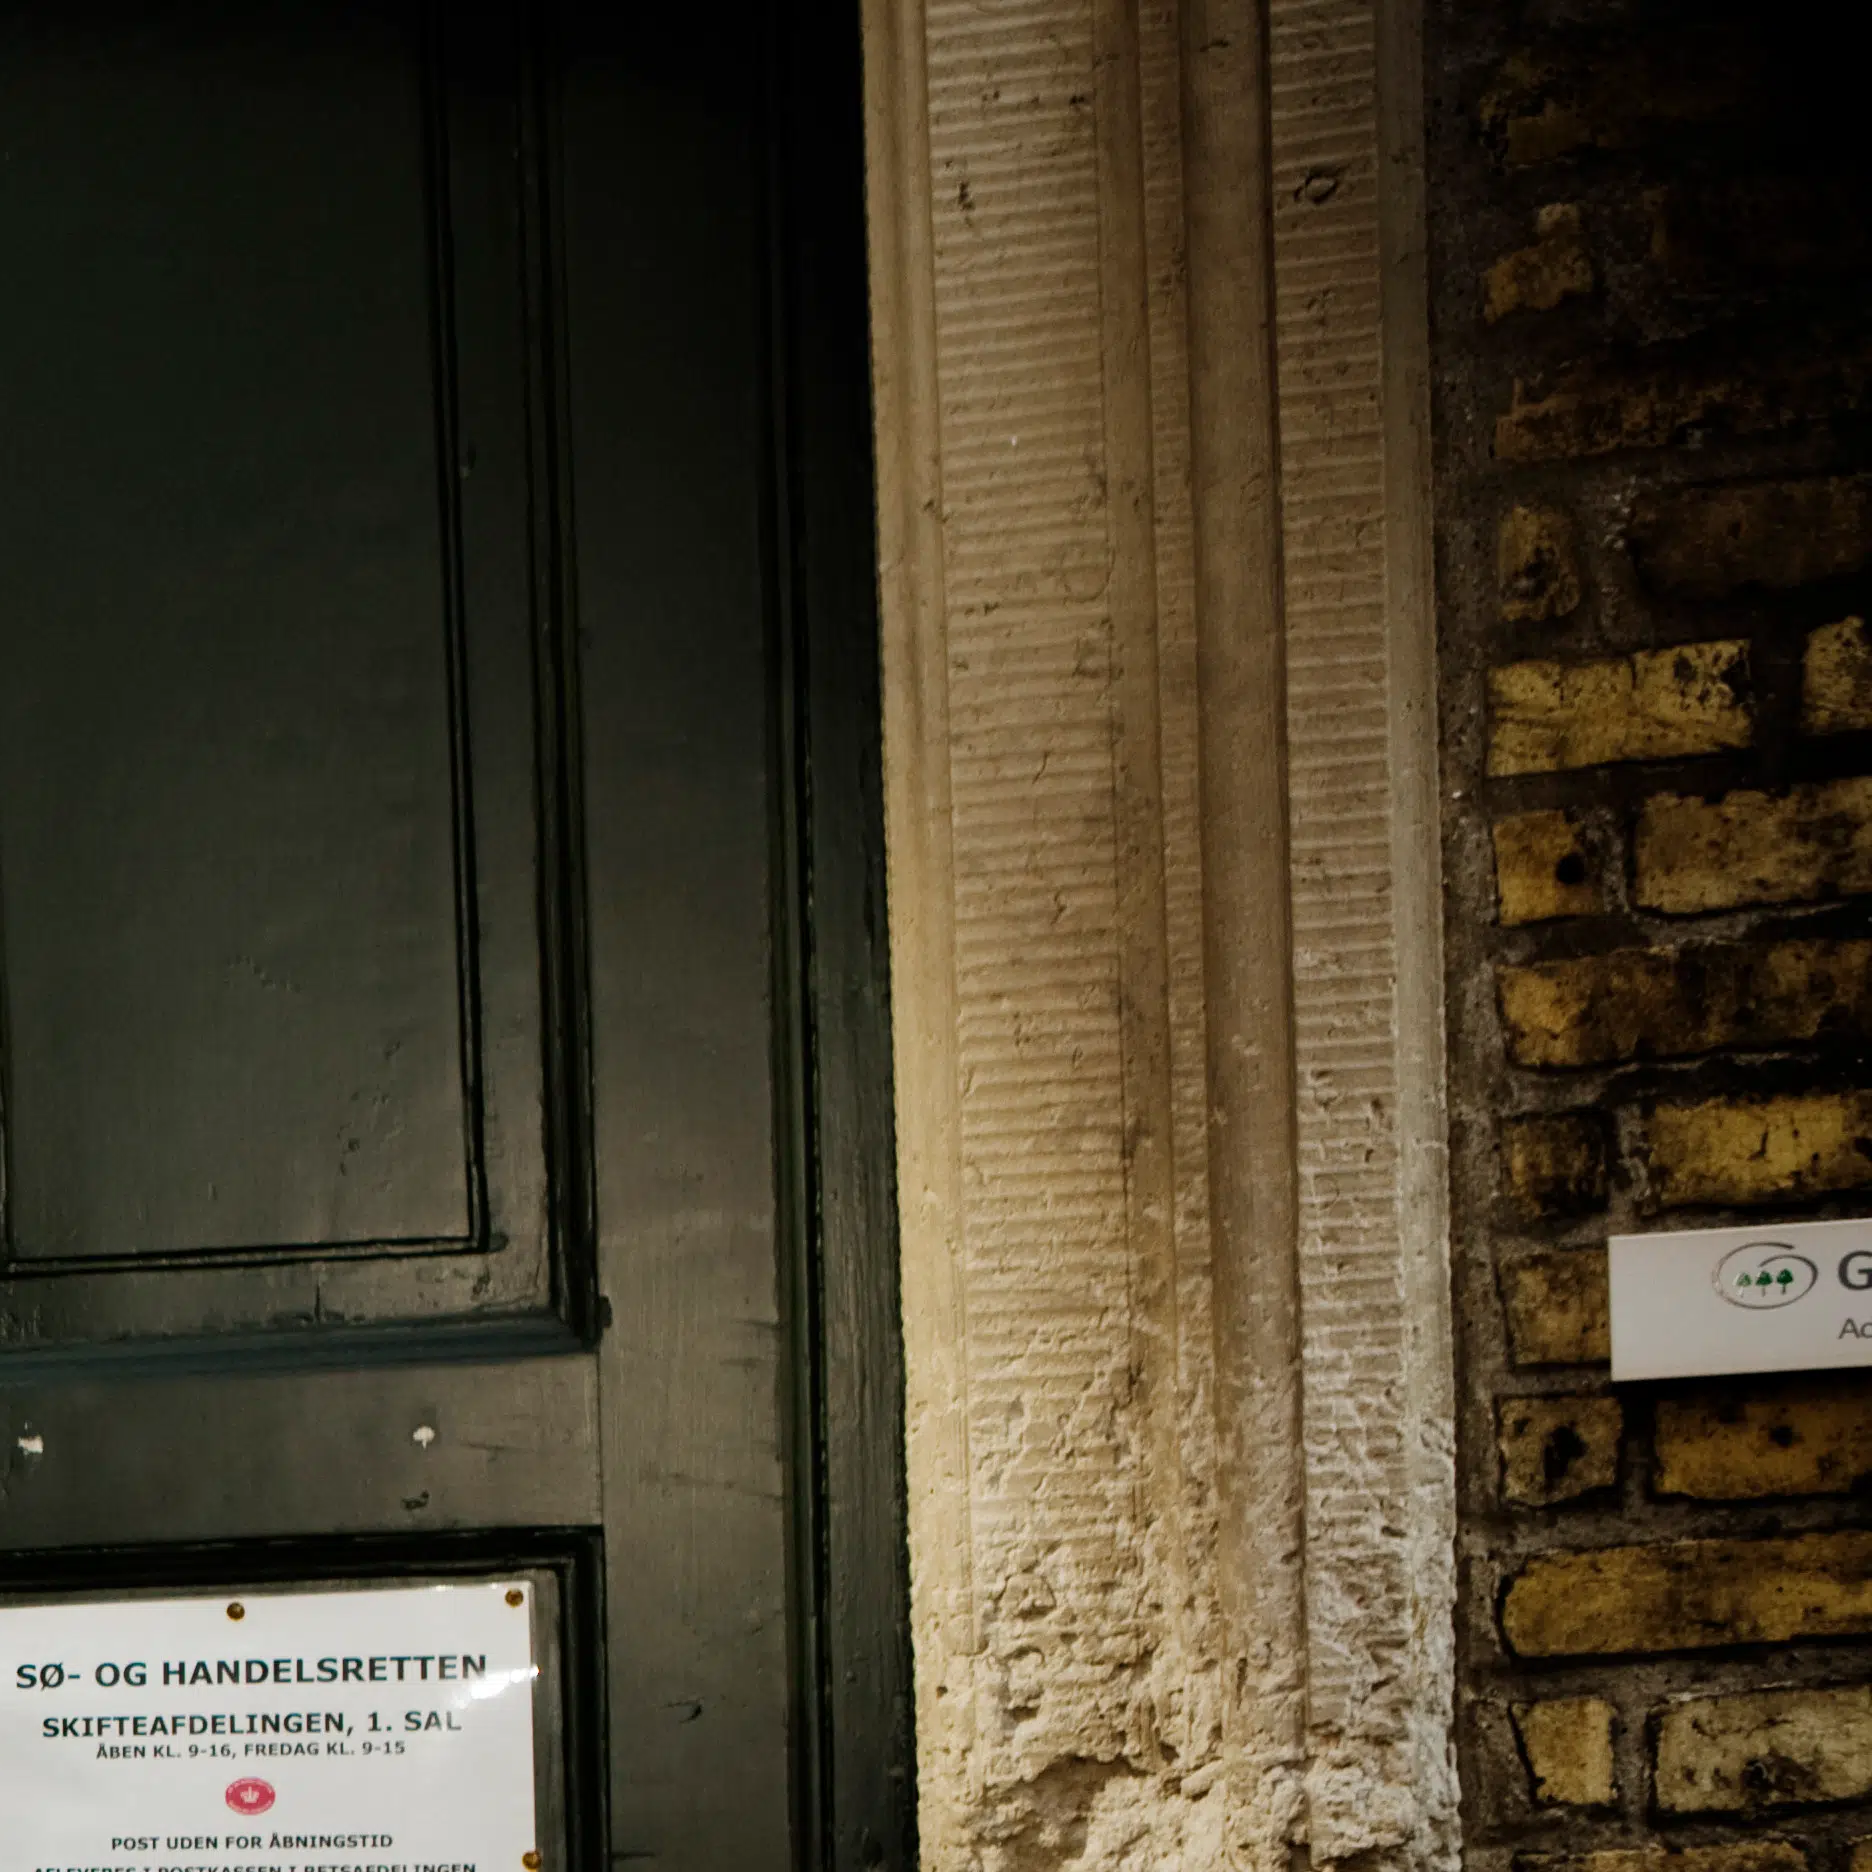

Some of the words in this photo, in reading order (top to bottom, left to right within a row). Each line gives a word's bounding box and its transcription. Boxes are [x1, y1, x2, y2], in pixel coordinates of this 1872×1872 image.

[15, 1662, 81, 1691] SØ-
[94, 1661, 148, 1687] OG
[162, 1655, 487, 1686] HANDELSRETTEN
[42, 1712, 354, 1738] SKIFTEAFDELINGEN,
[367, 1711, 393, 1732] 1.
[404, 1710, 462, 1732] SAL
[96, 1742, 146, 1759] ÅBEN
[153, 1744, 182, 1758] KL.
[188, 1743, 237, 1759] 9-16,
[244, 1742, 320, 1757] FREDAG
[326, 1741, 356, 1756] KL.
[361, 1740, 406, 1756] 9-15
[111, 1836, 160, 1851] POST
[166, 1836, 218, 1850] UDEN
[225, 1835, 263, 1850] FOR
[269, 1831, 393, 1849] ÅBNINGSTID
